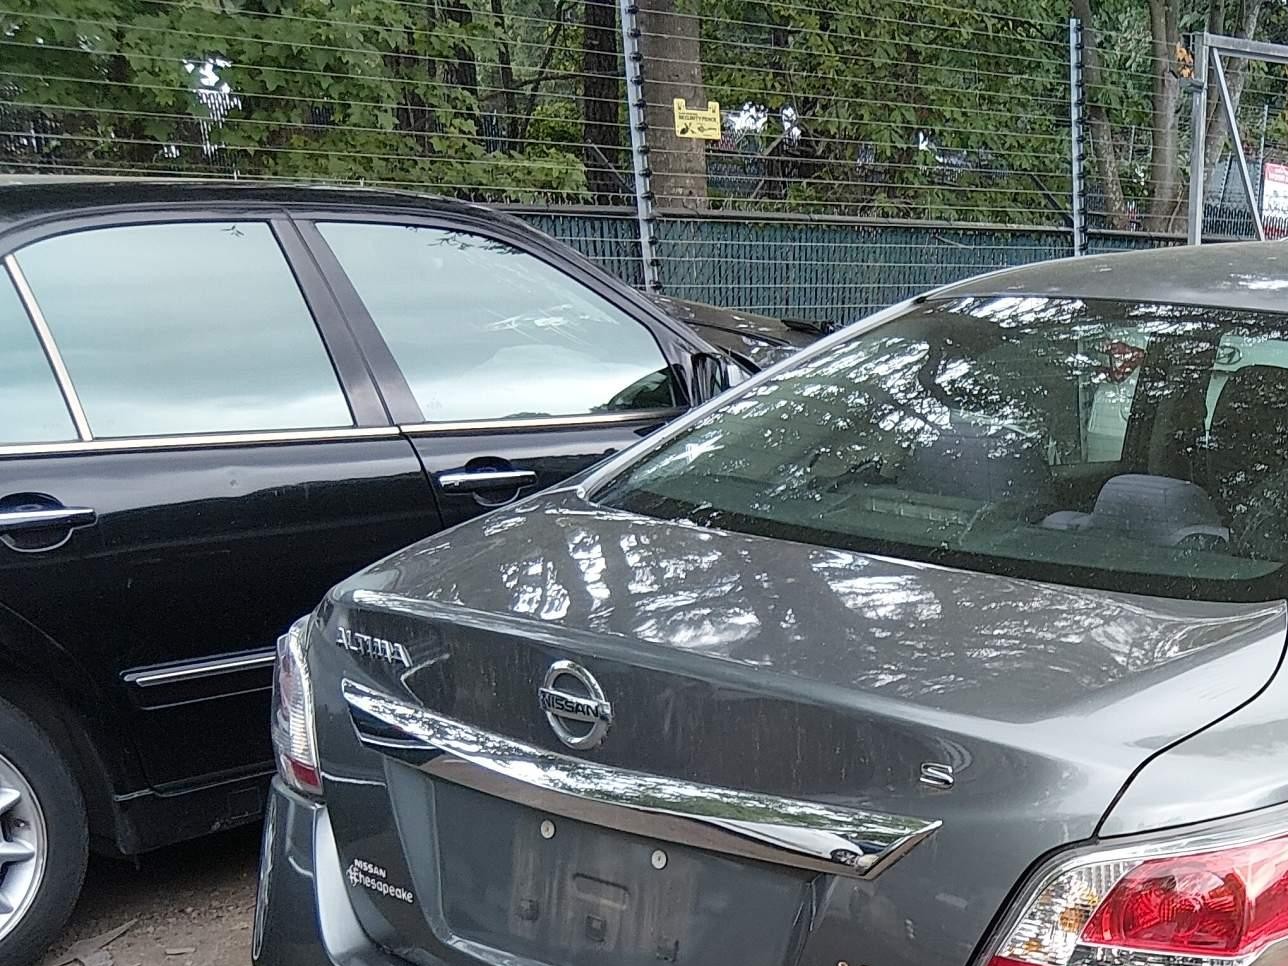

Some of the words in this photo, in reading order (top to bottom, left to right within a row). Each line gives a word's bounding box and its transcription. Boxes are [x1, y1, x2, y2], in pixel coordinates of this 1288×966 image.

[541, 693, 599, 718] NISSAN
[919, 762, 954, 789] S
[354, 858, 387, 878] NISSAN
[352, 870, 414, 904] Chesapeake
